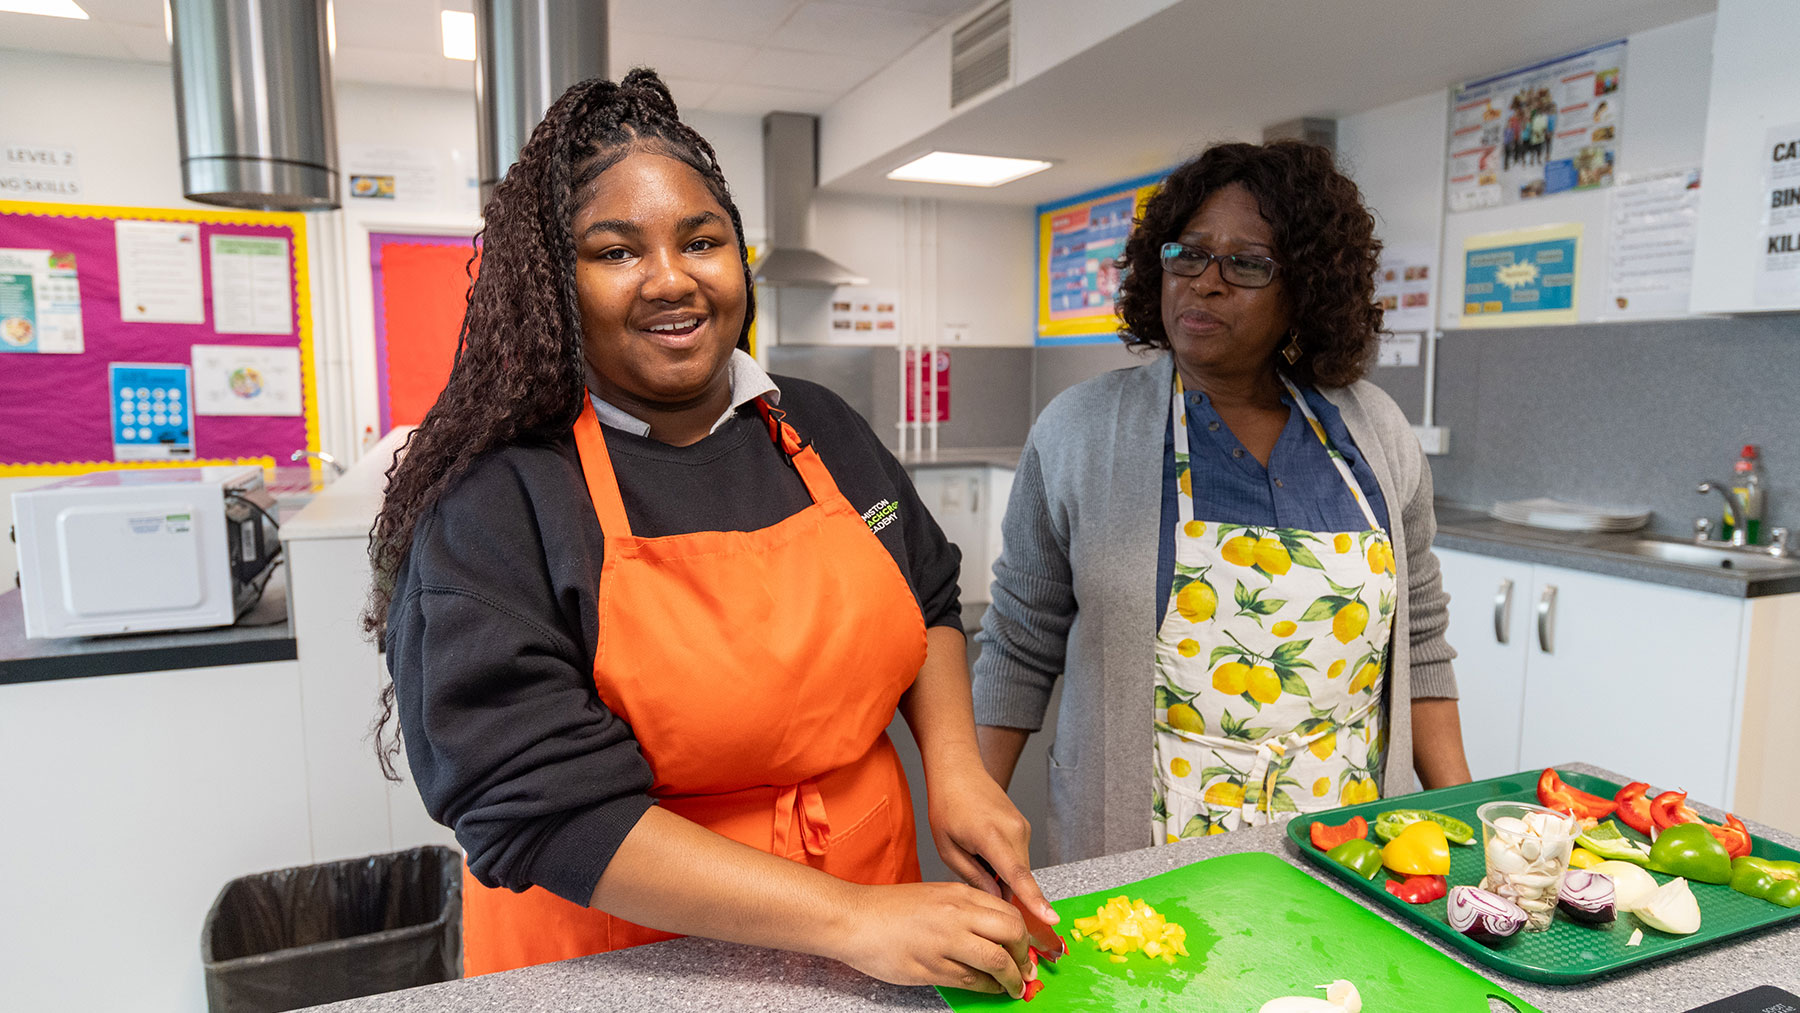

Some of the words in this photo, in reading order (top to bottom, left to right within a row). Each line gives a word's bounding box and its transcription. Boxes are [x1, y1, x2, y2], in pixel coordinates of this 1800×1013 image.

[6, 147, 58, 166] LEVEL
[63, 150, 74, 167] 2
[24, 179, 79, 194] SKILLS
